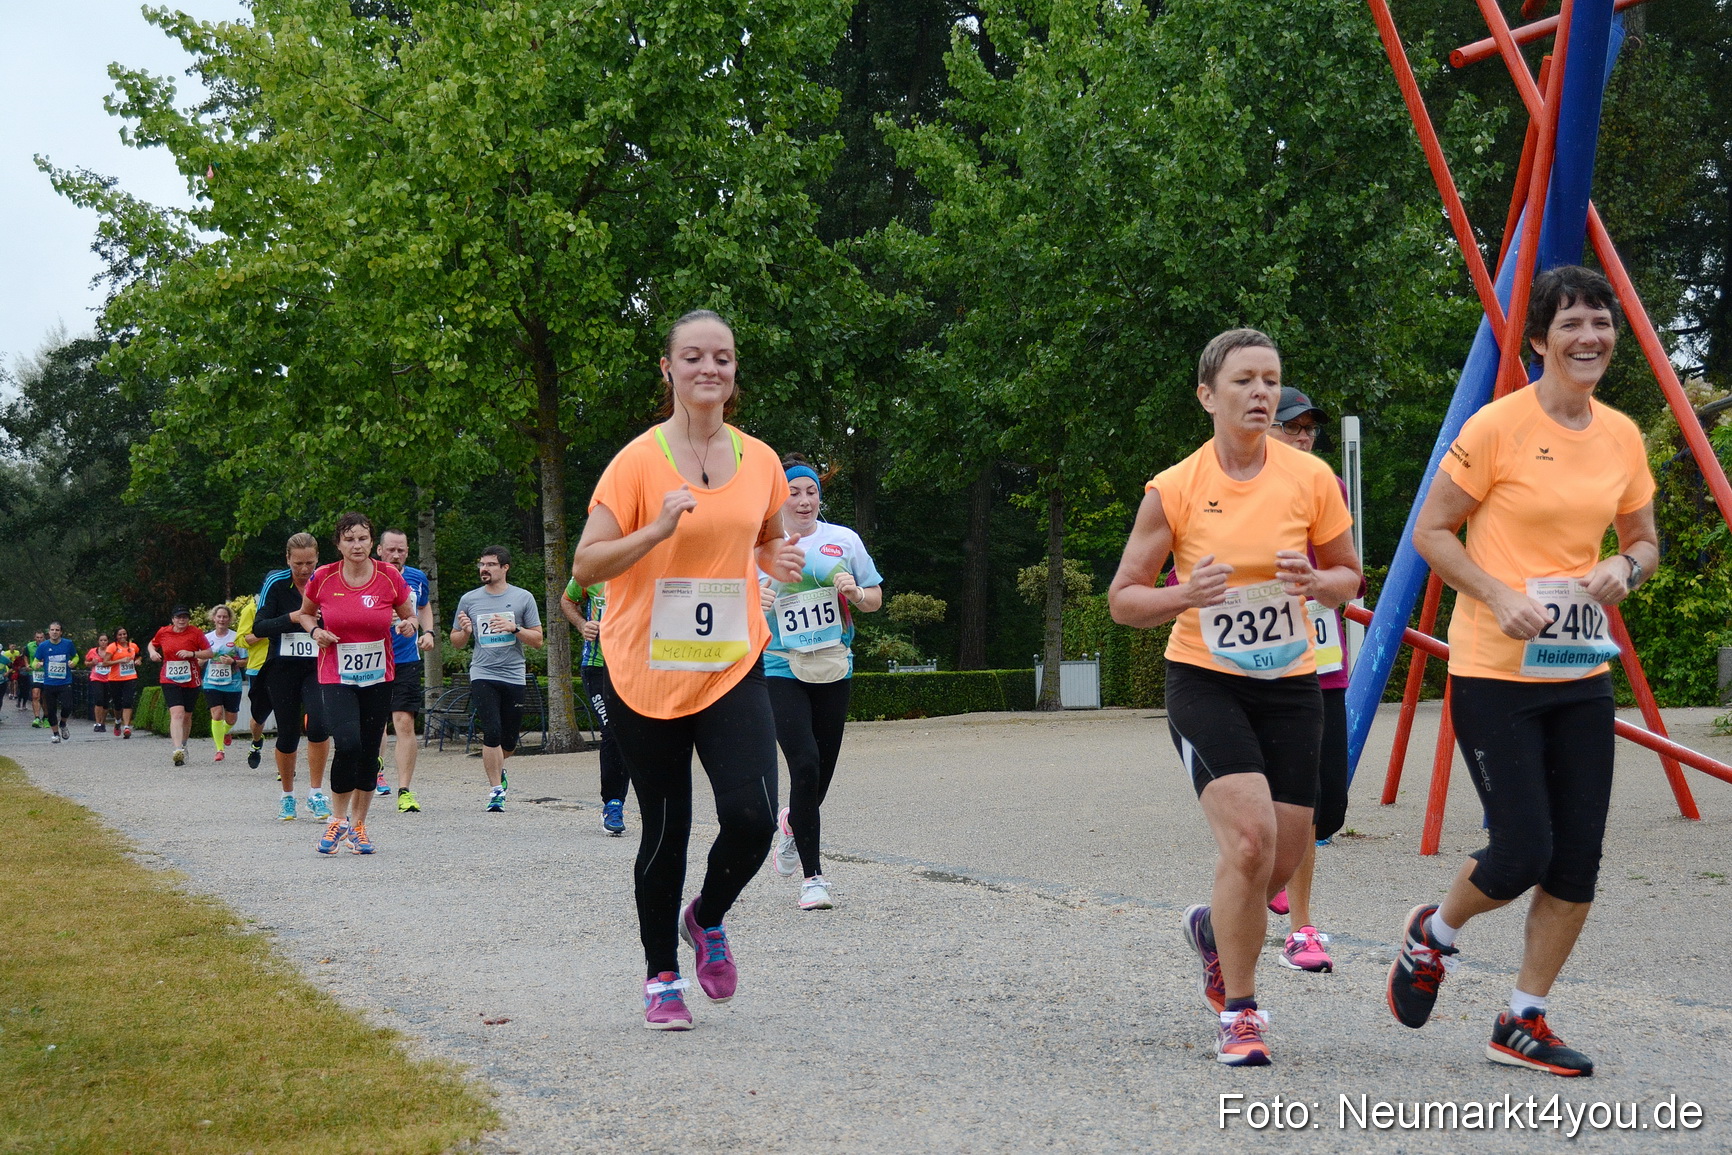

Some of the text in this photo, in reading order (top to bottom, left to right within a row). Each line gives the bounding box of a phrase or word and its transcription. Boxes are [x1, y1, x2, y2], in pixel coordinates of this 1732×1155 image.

[699, 582, 740, 594] BOCK
[803, 590, 832, 601] BOCK
[1246, 582, 1286, 601] BOC
[695, 602, 713, 636] 9
[784, 601, 835, 632] 3115
[1538, 603, 1605, 640] 2402
[1213, 601, 1294, 648] 2321
[799, 634, 823, 645] Anna
[290, 642, 312, 655] 109
[662, 645, 722, 659] Melinda
[343, 651, 383, 671] 2877
[1253, 652, 1274, 667] Evi
[1537, 649, 1611, 664] Heidemarie
[168, 665, 189, 675] 2322
[210, 668, 230, 677] 2265
[352, 673, 375, 681] Marion
[591, 693, 609, 726] SKULL
